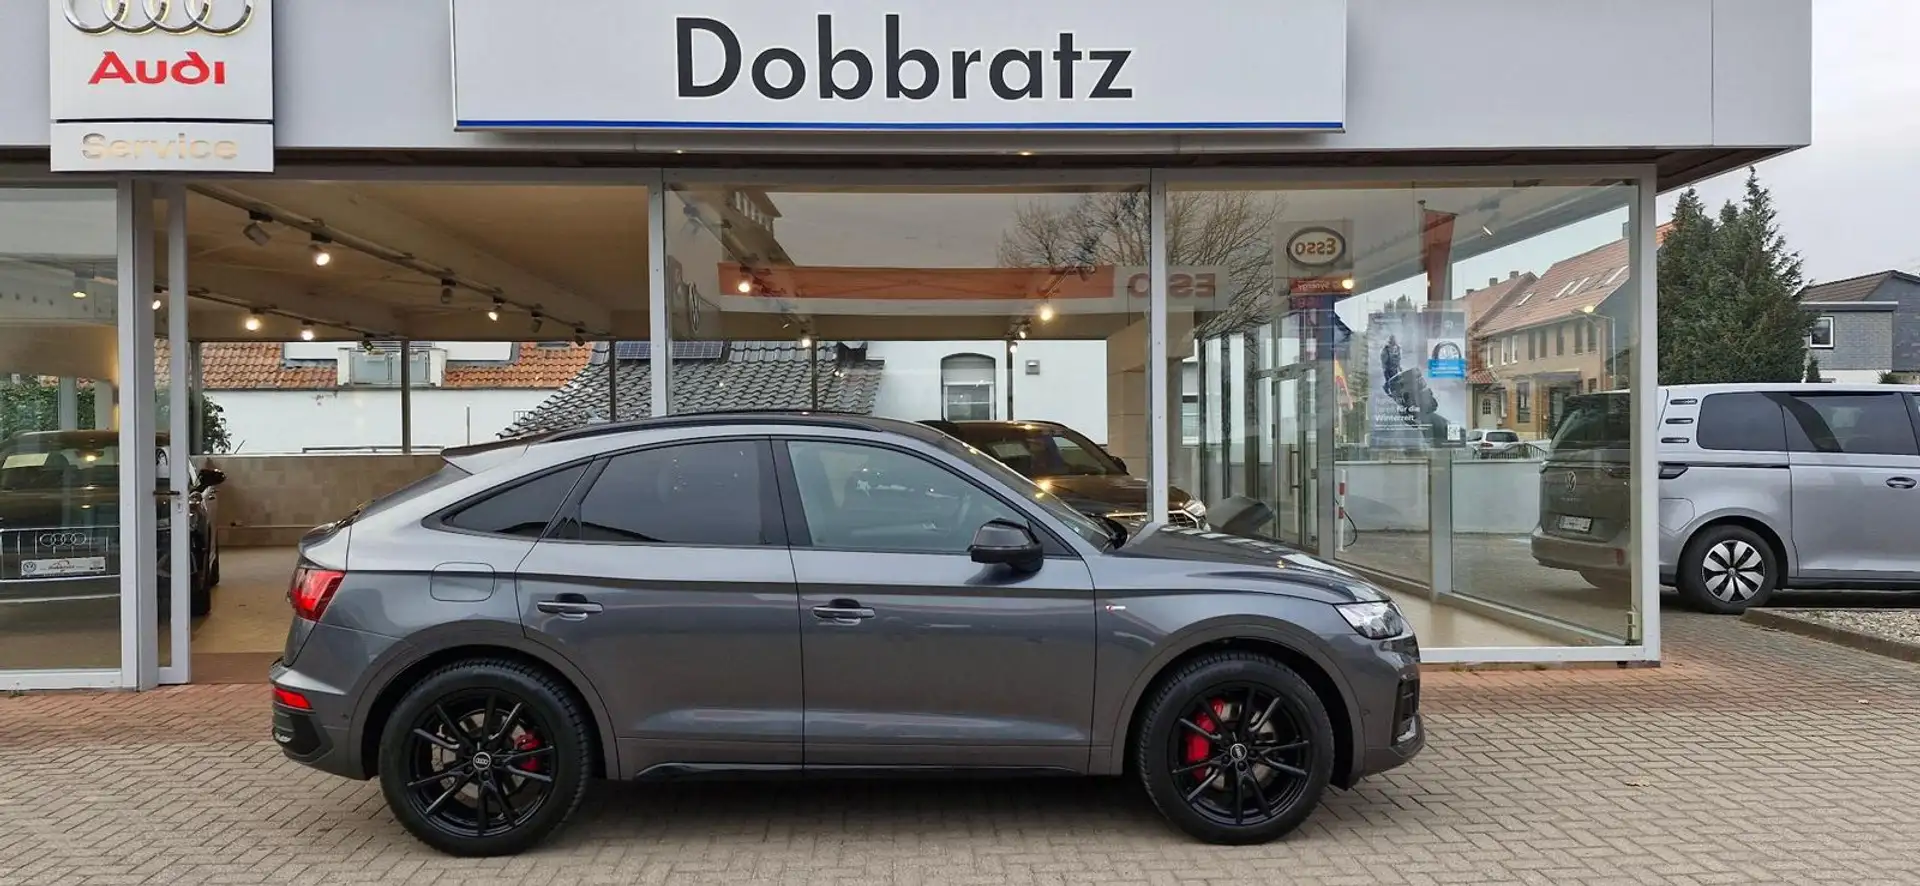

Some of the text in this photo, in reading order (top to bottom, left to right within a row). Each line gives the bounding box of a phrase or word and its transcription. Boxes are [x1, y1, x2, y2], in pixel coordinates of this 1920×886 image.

[88, 51, 226, 85] Audi
[676, 14, 1133, 100] Dobbratz
[82, 132, 238, 160] Service
